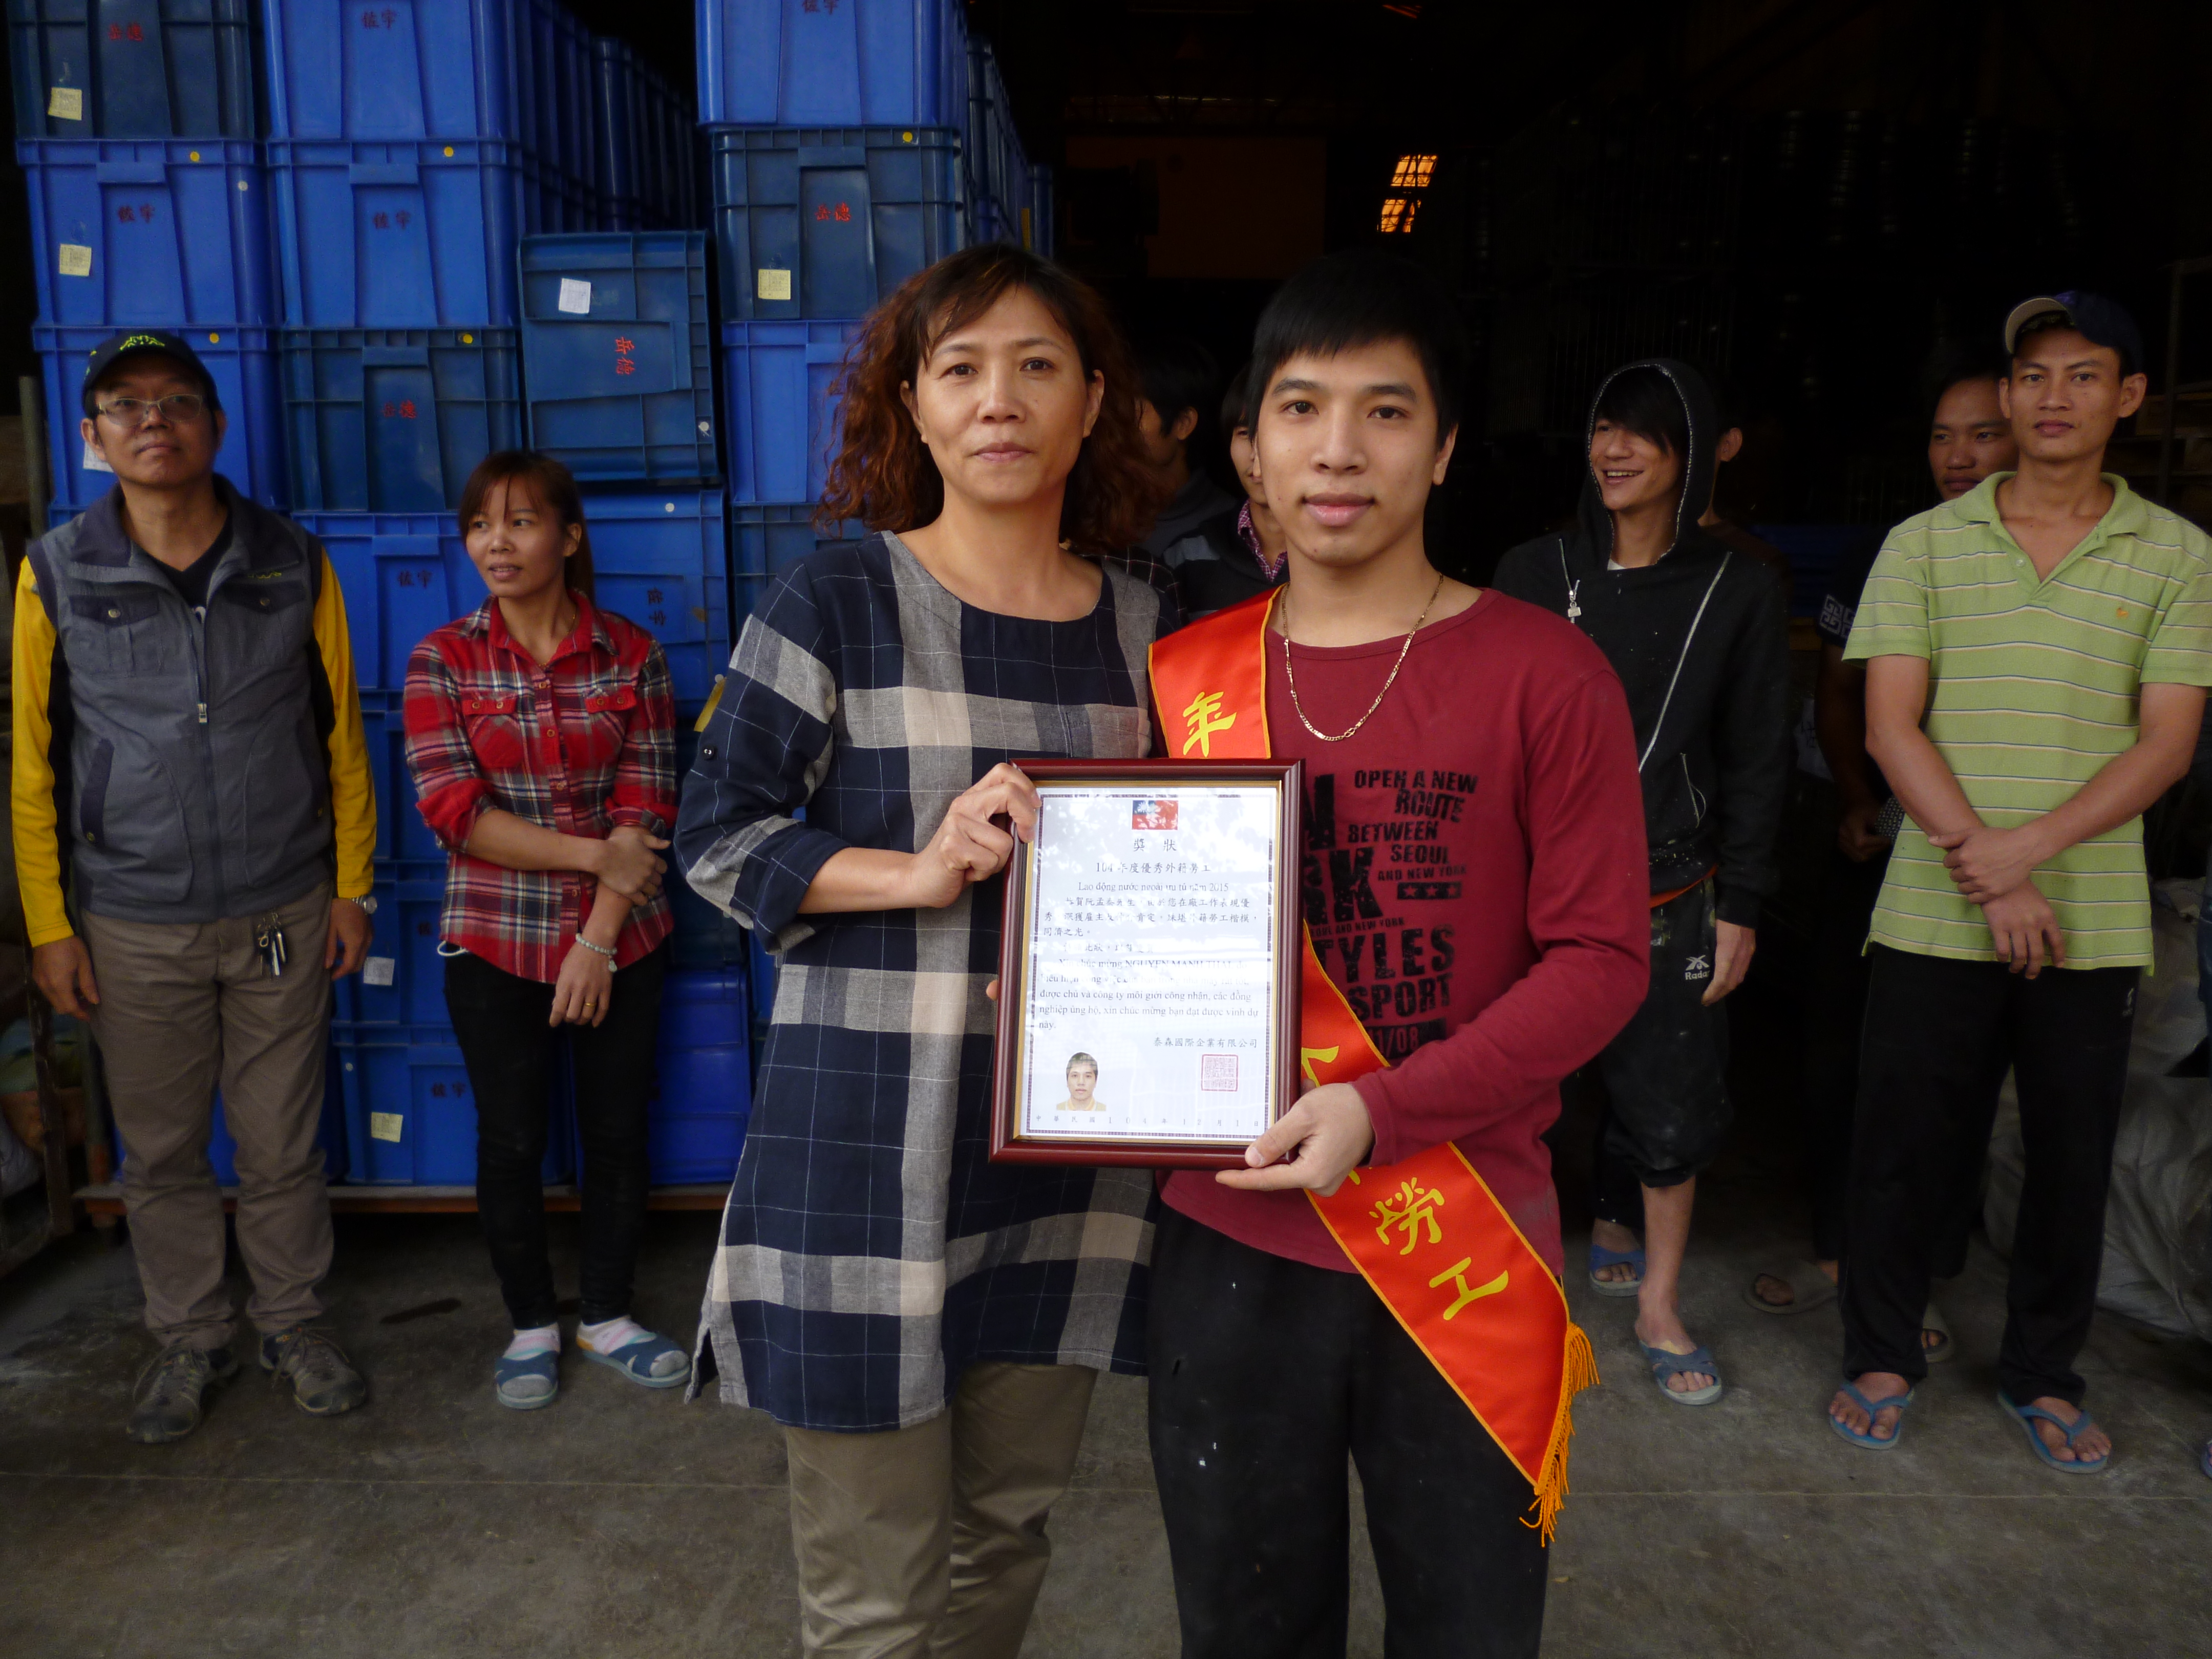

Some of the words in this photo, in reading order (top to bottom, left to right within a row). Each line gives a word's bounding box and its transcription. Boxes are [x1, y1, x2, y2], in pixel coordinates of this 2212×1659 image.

[1183, 691, 1237, 758] 年
[1354, 769, 1407, 789] OPEN
[1413, 770, 1426, 789] A
[1432, 770, 1479, 794] NEW
[1394, 788, 1466, 823] ROUTE
[1347, 820, 1440, 843] BETWEEN
[1390, 843, 1450, 865] SEOUL
[1096, 862, 1113, 872] 104
[1378, 869, 1402, 881] AND
[1407, 867, 1435, 879] NEW
[1078, 882, 1094, 891] Lao
[1096, 882, 1116, 892] động
[1118, 882, 1139, 891] nước
[1209, 883, 1229, 892] 2015
[1336, 923, 1352, 934] AND
[1355, 920, 1377, 931] NEW
[1039, 989, 1061, 999] được
[1093, 990, 1113, 1001] công
[1116, 991, 1124, 1001] ty
[1126, 991, 1143, 999] môi
[1145, 991, 1162, 1001] giới
[1164, 991, 1185, 1002] công
[1213, 992, 1227, 1001] các
[1230, 989, 1251, 1002] đồng
[1347, 972, 1454, 1022] SPORT
[1039, 1005, 1068, 1015] nghiệp
[1119, 1006, 1140, 1014] chúc
[1169, 1007, 1184, 1017] bạn
[1186, 1007, 1200, 1017] đạt
[1202, 1007, 1223, 1017] được
[1226, 1008, 1245, 1016] vinh
[1247, 1008, 1259, 1018] dự
[1039, 1020, 1056, 1030] này.
[1153, 1036, 1258, 1048] 泰森國際企業有限公司
[1369, 1177, 1509, 1320] 勞工
